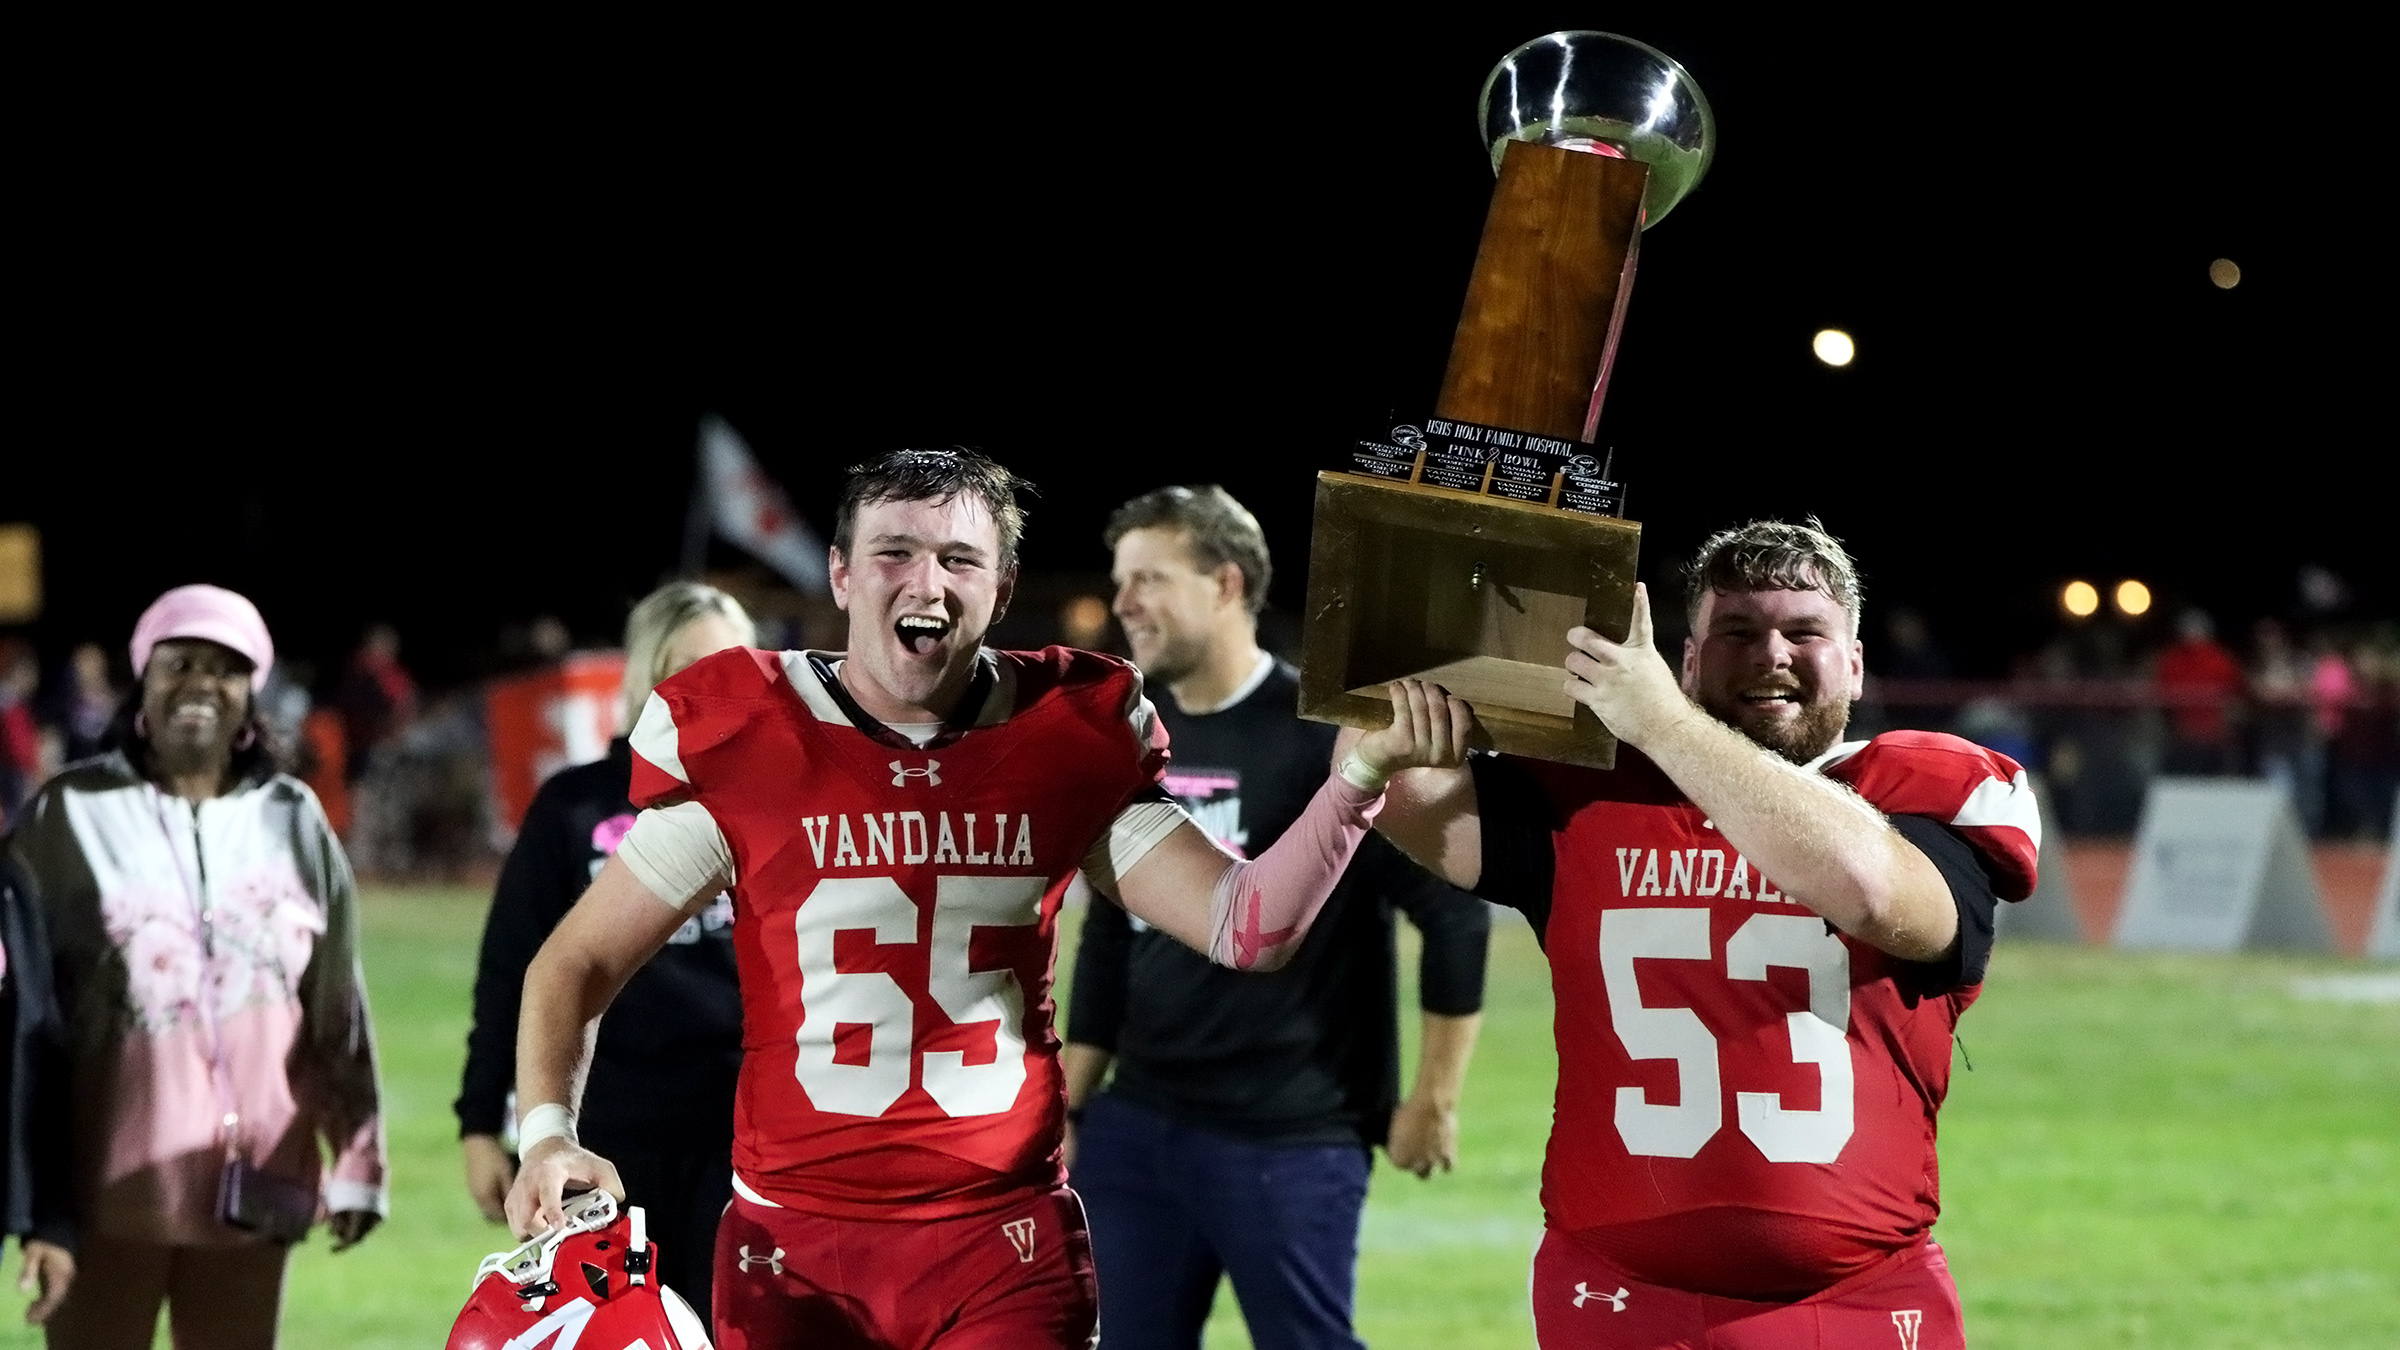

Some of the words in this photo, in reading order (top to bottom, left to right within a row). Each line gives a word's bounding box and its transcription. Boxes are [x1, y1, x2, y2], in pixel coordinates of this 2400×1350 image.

[1426, 419, 1453, 437] HSHS
[1454, 424, 1483, 442] HOLY
[1485, 429, 1524, 449] FAMILY
[1525, 436, 1573, 458] HOSPITAL
[1360, 440, 1415, 455] GREENVILLE
[1369, 446, 1404, 457] COMETS
[1428, 451, 1487, 465] GREENVILLE
[1437, 458, 1475, 468] COMETS
[1448, 444, 1486, 460] PINK
[1503, 453, 1542, 469] BOWL
[1355, 457, 1410, 471] GREENVILLE
[1364, 463, 1399, 473] COMETS
[1501, 464, 1547, 477] VANDALIA
[1426, 468, 1479, 482] VANDALIA
[1428, 473, 1476, 486] VANDALS
[1502, 470, 1544, 480] VANDALS
[1569, 475, 1619, 488] GREENVILLE
[1496, 481, 1543, 493] VANDALIA
[1498, 486, 1540, 497] VANDALS
[1575, 481, 1610, 491] COMETS
[1565, 492, 1612, 504] VANDALIA
[1566, 498, 1609, 508] VANDALS
[801, 811, 1034, 869] VANDALIA
[1615, 848, 1797, 904] VANDAL
[795, 874, 1050, 1118] 65
[1599, 907, 1855, 1164] 53
[1001, 1216, 1036, 1263] V
